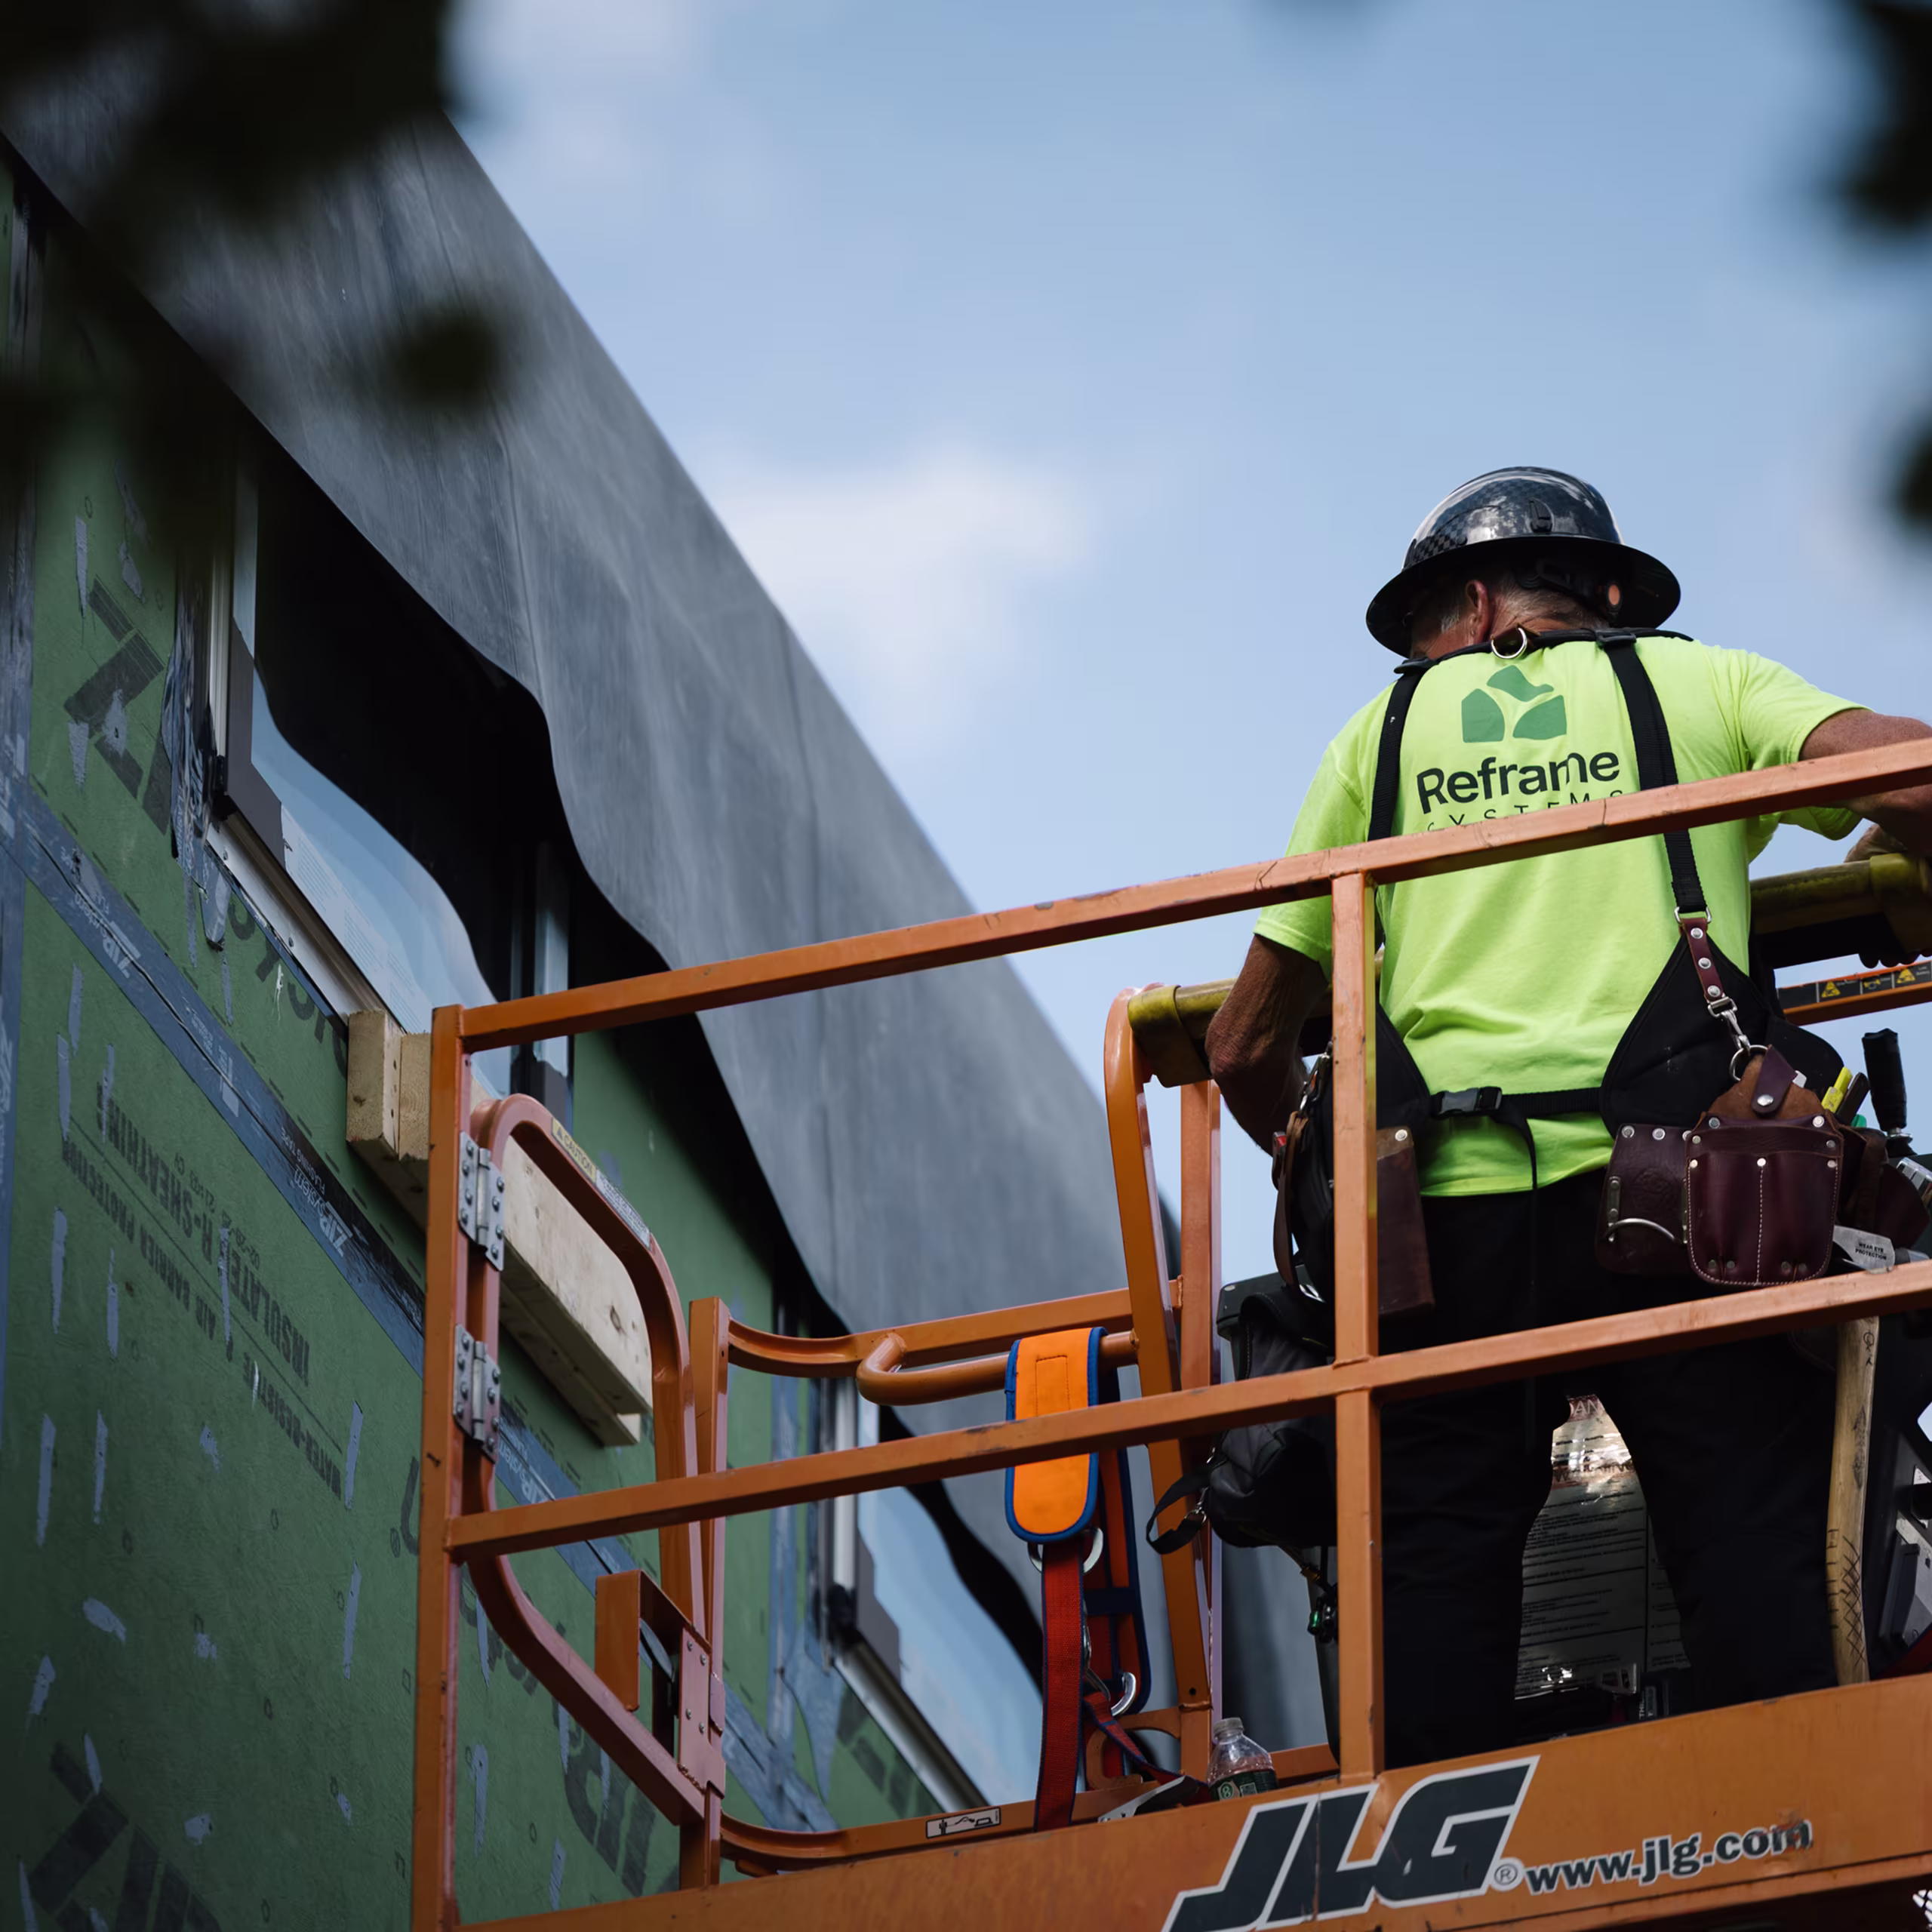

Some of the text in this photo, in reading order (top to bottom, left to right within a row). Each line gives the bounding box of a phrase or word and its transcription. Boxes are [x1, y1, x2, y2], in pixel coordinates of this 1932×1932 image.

[1417, 752, 1620, 815] Reframe
[565, 1135, 593, 1175] CAUTION
[1855, 1248, 1887, 1260] PROTECTION
[1859, 1242, 1873, 1251] WEAR
[1161, 1755, 1814, 1932] JLG www.jlg.com
